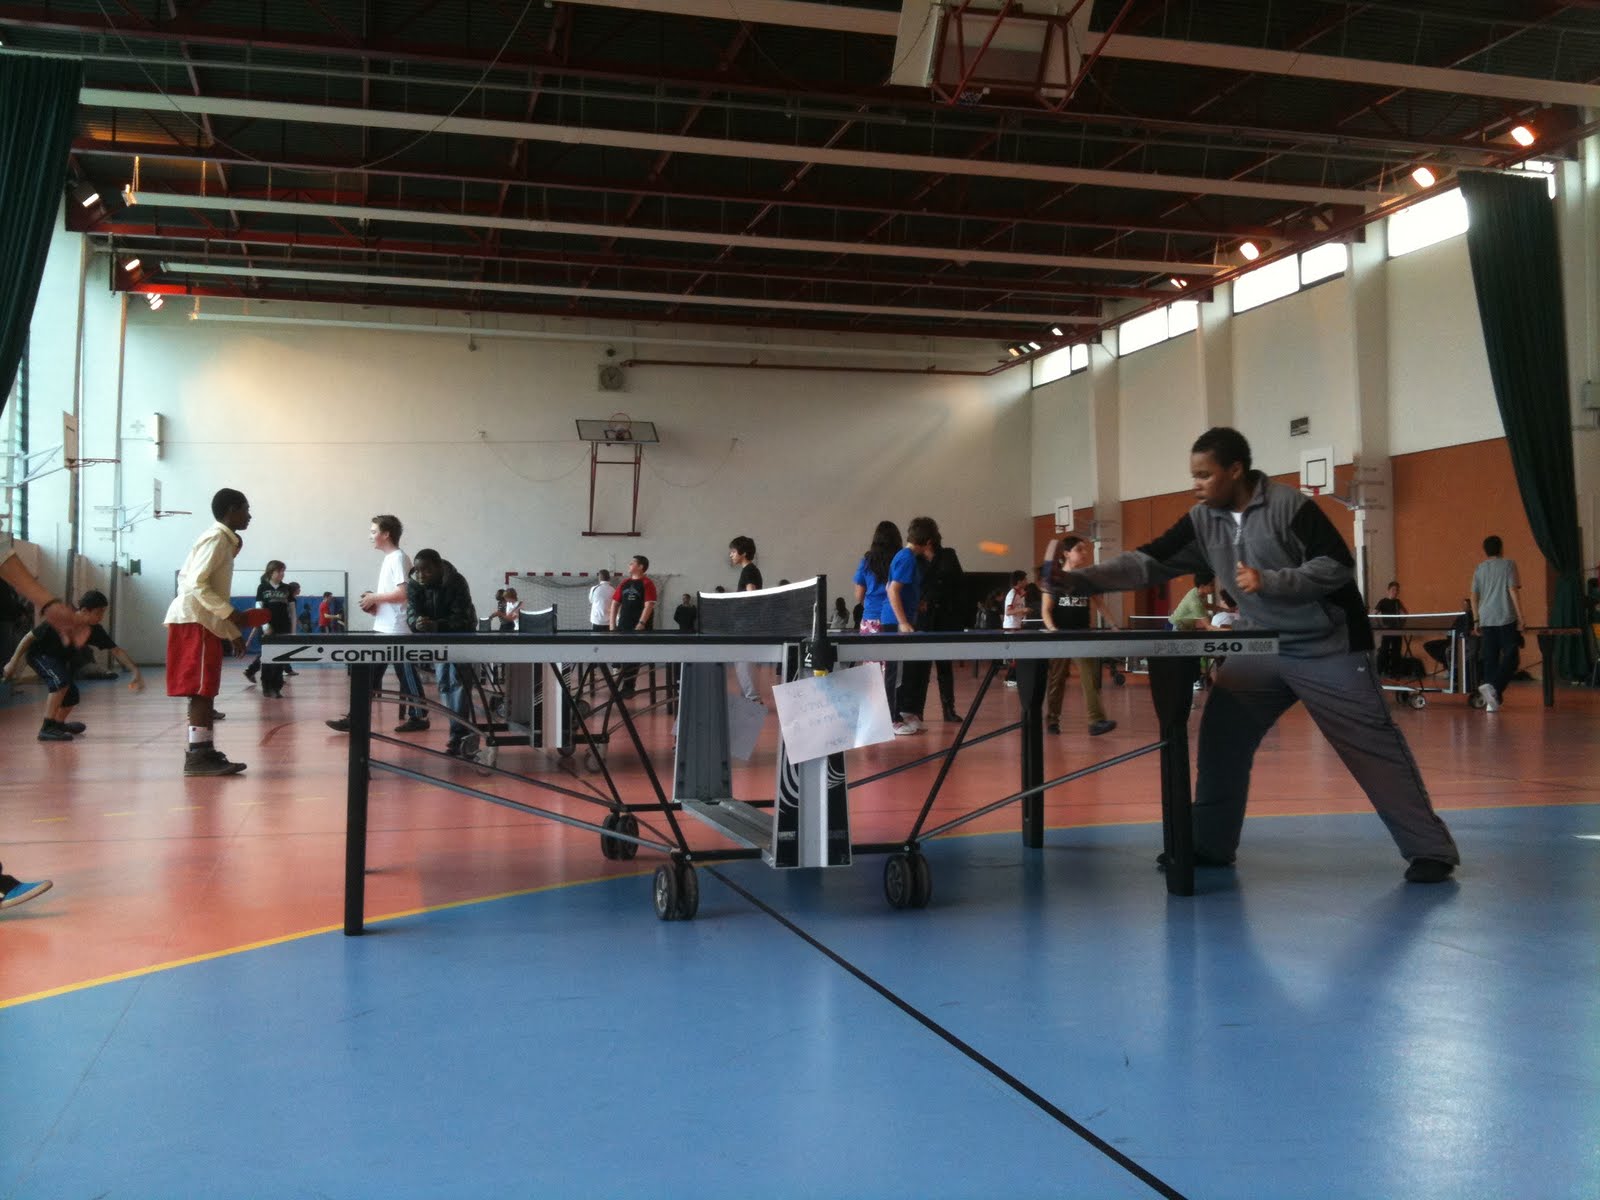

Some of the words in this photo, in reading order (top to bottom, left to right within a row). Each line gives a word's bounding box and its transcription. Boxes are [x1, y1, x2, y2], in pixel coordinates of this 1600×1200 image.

[330, 646, 448, 662] cornilleau
[1153, 641, 1196, 654] PRO
[1203, 641, 1243, 652] 540
